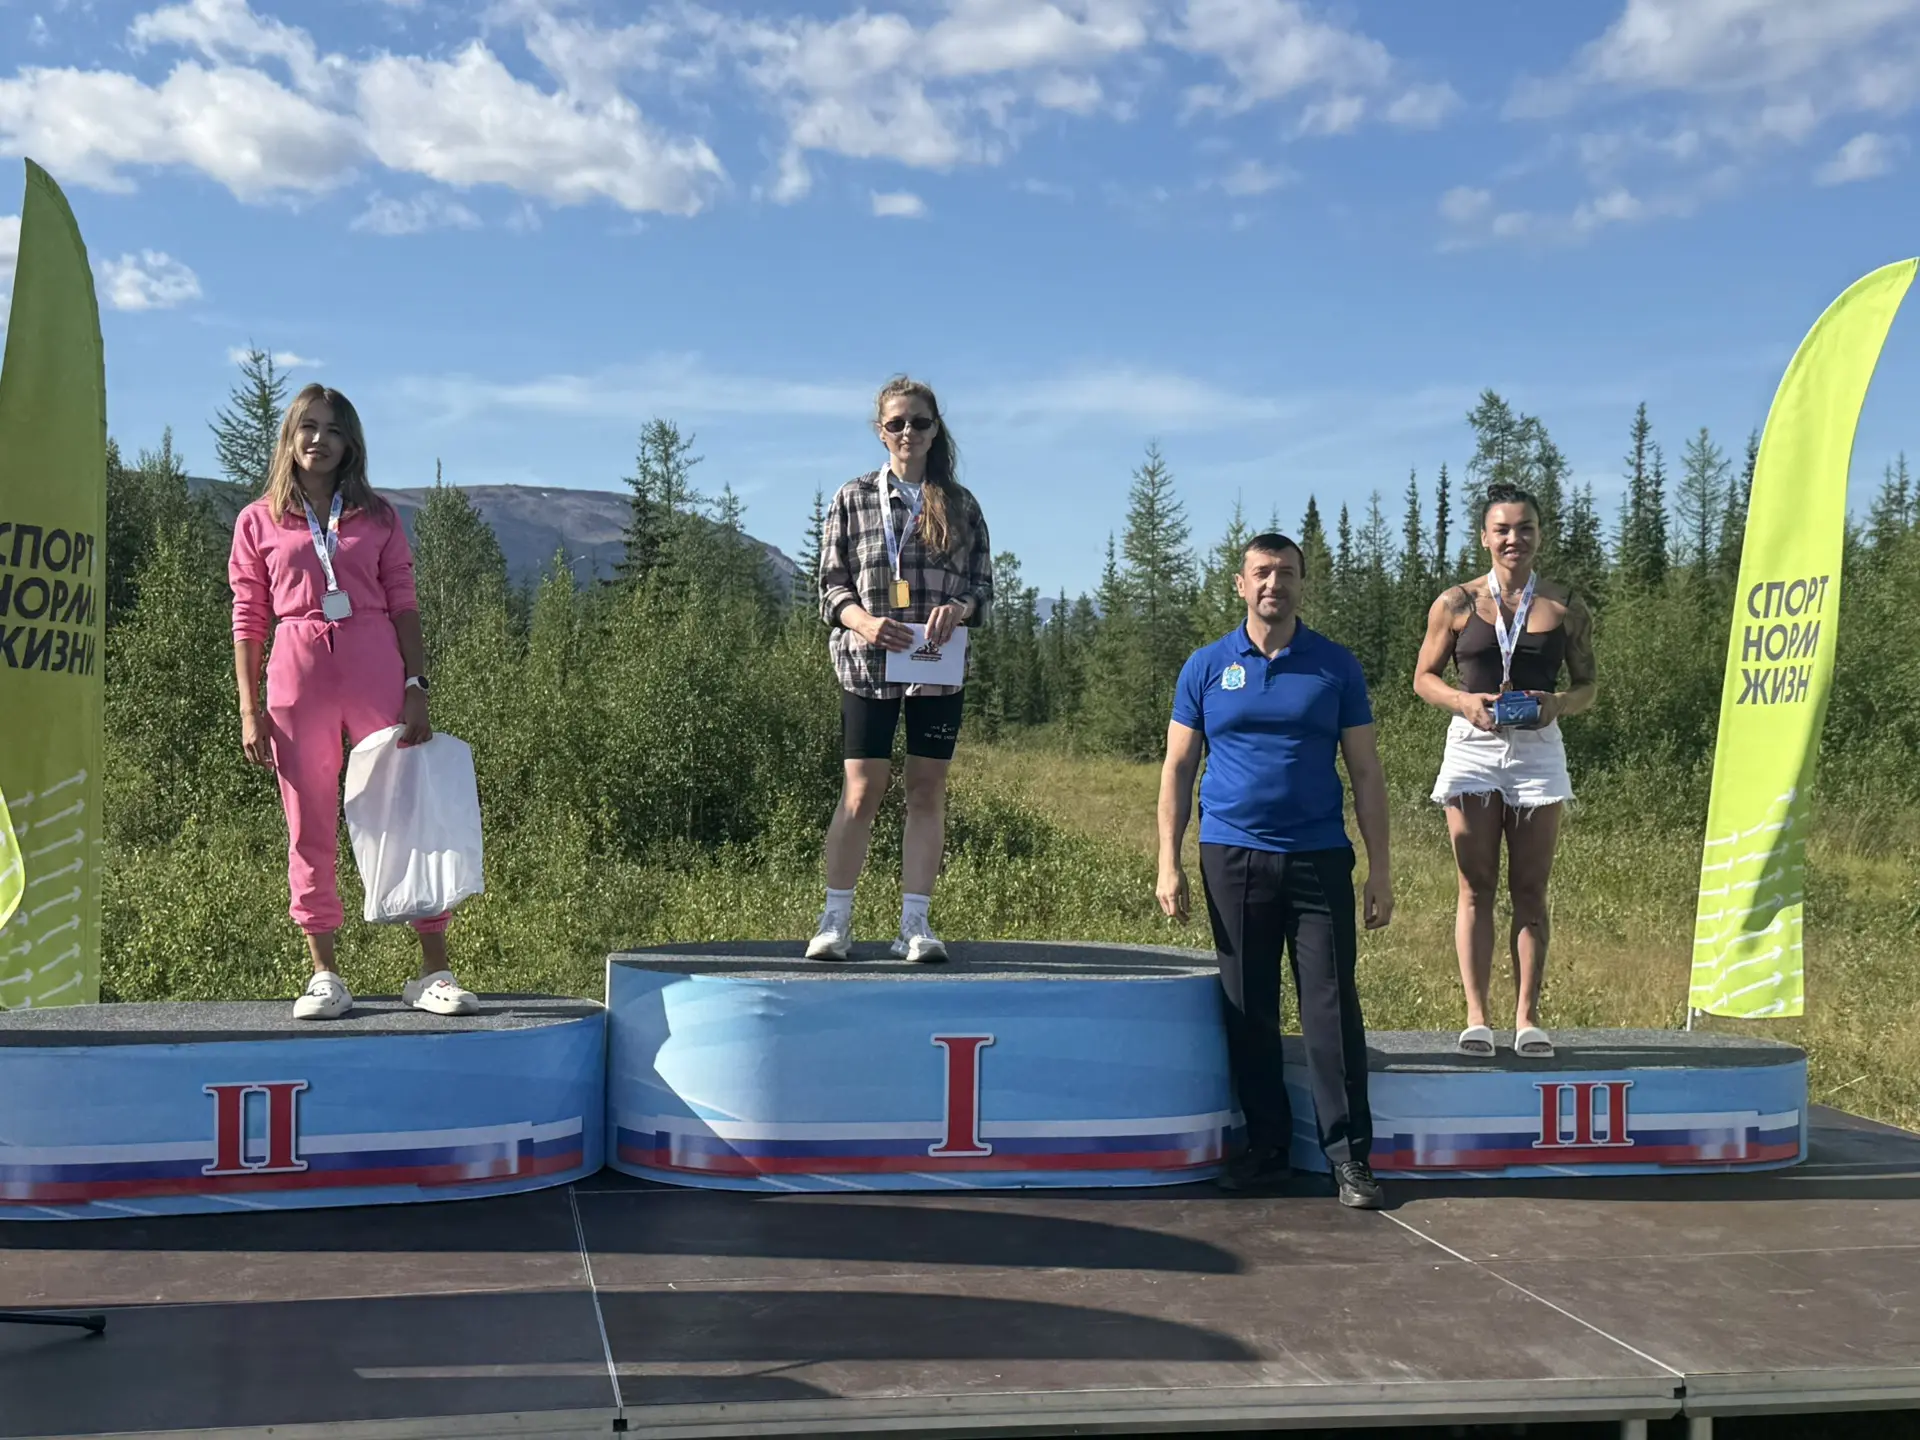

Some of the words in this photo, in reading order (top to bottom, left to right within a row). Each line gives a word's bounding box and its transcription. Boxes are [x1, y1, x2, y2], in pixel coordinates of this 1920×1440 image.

[1747, 575, 1829, 619] СПОРТ
[201, 1080, 308, 1176] II
[928, 1033, 995, 1157] I
[1532, 1080, 1635, 1149] III
